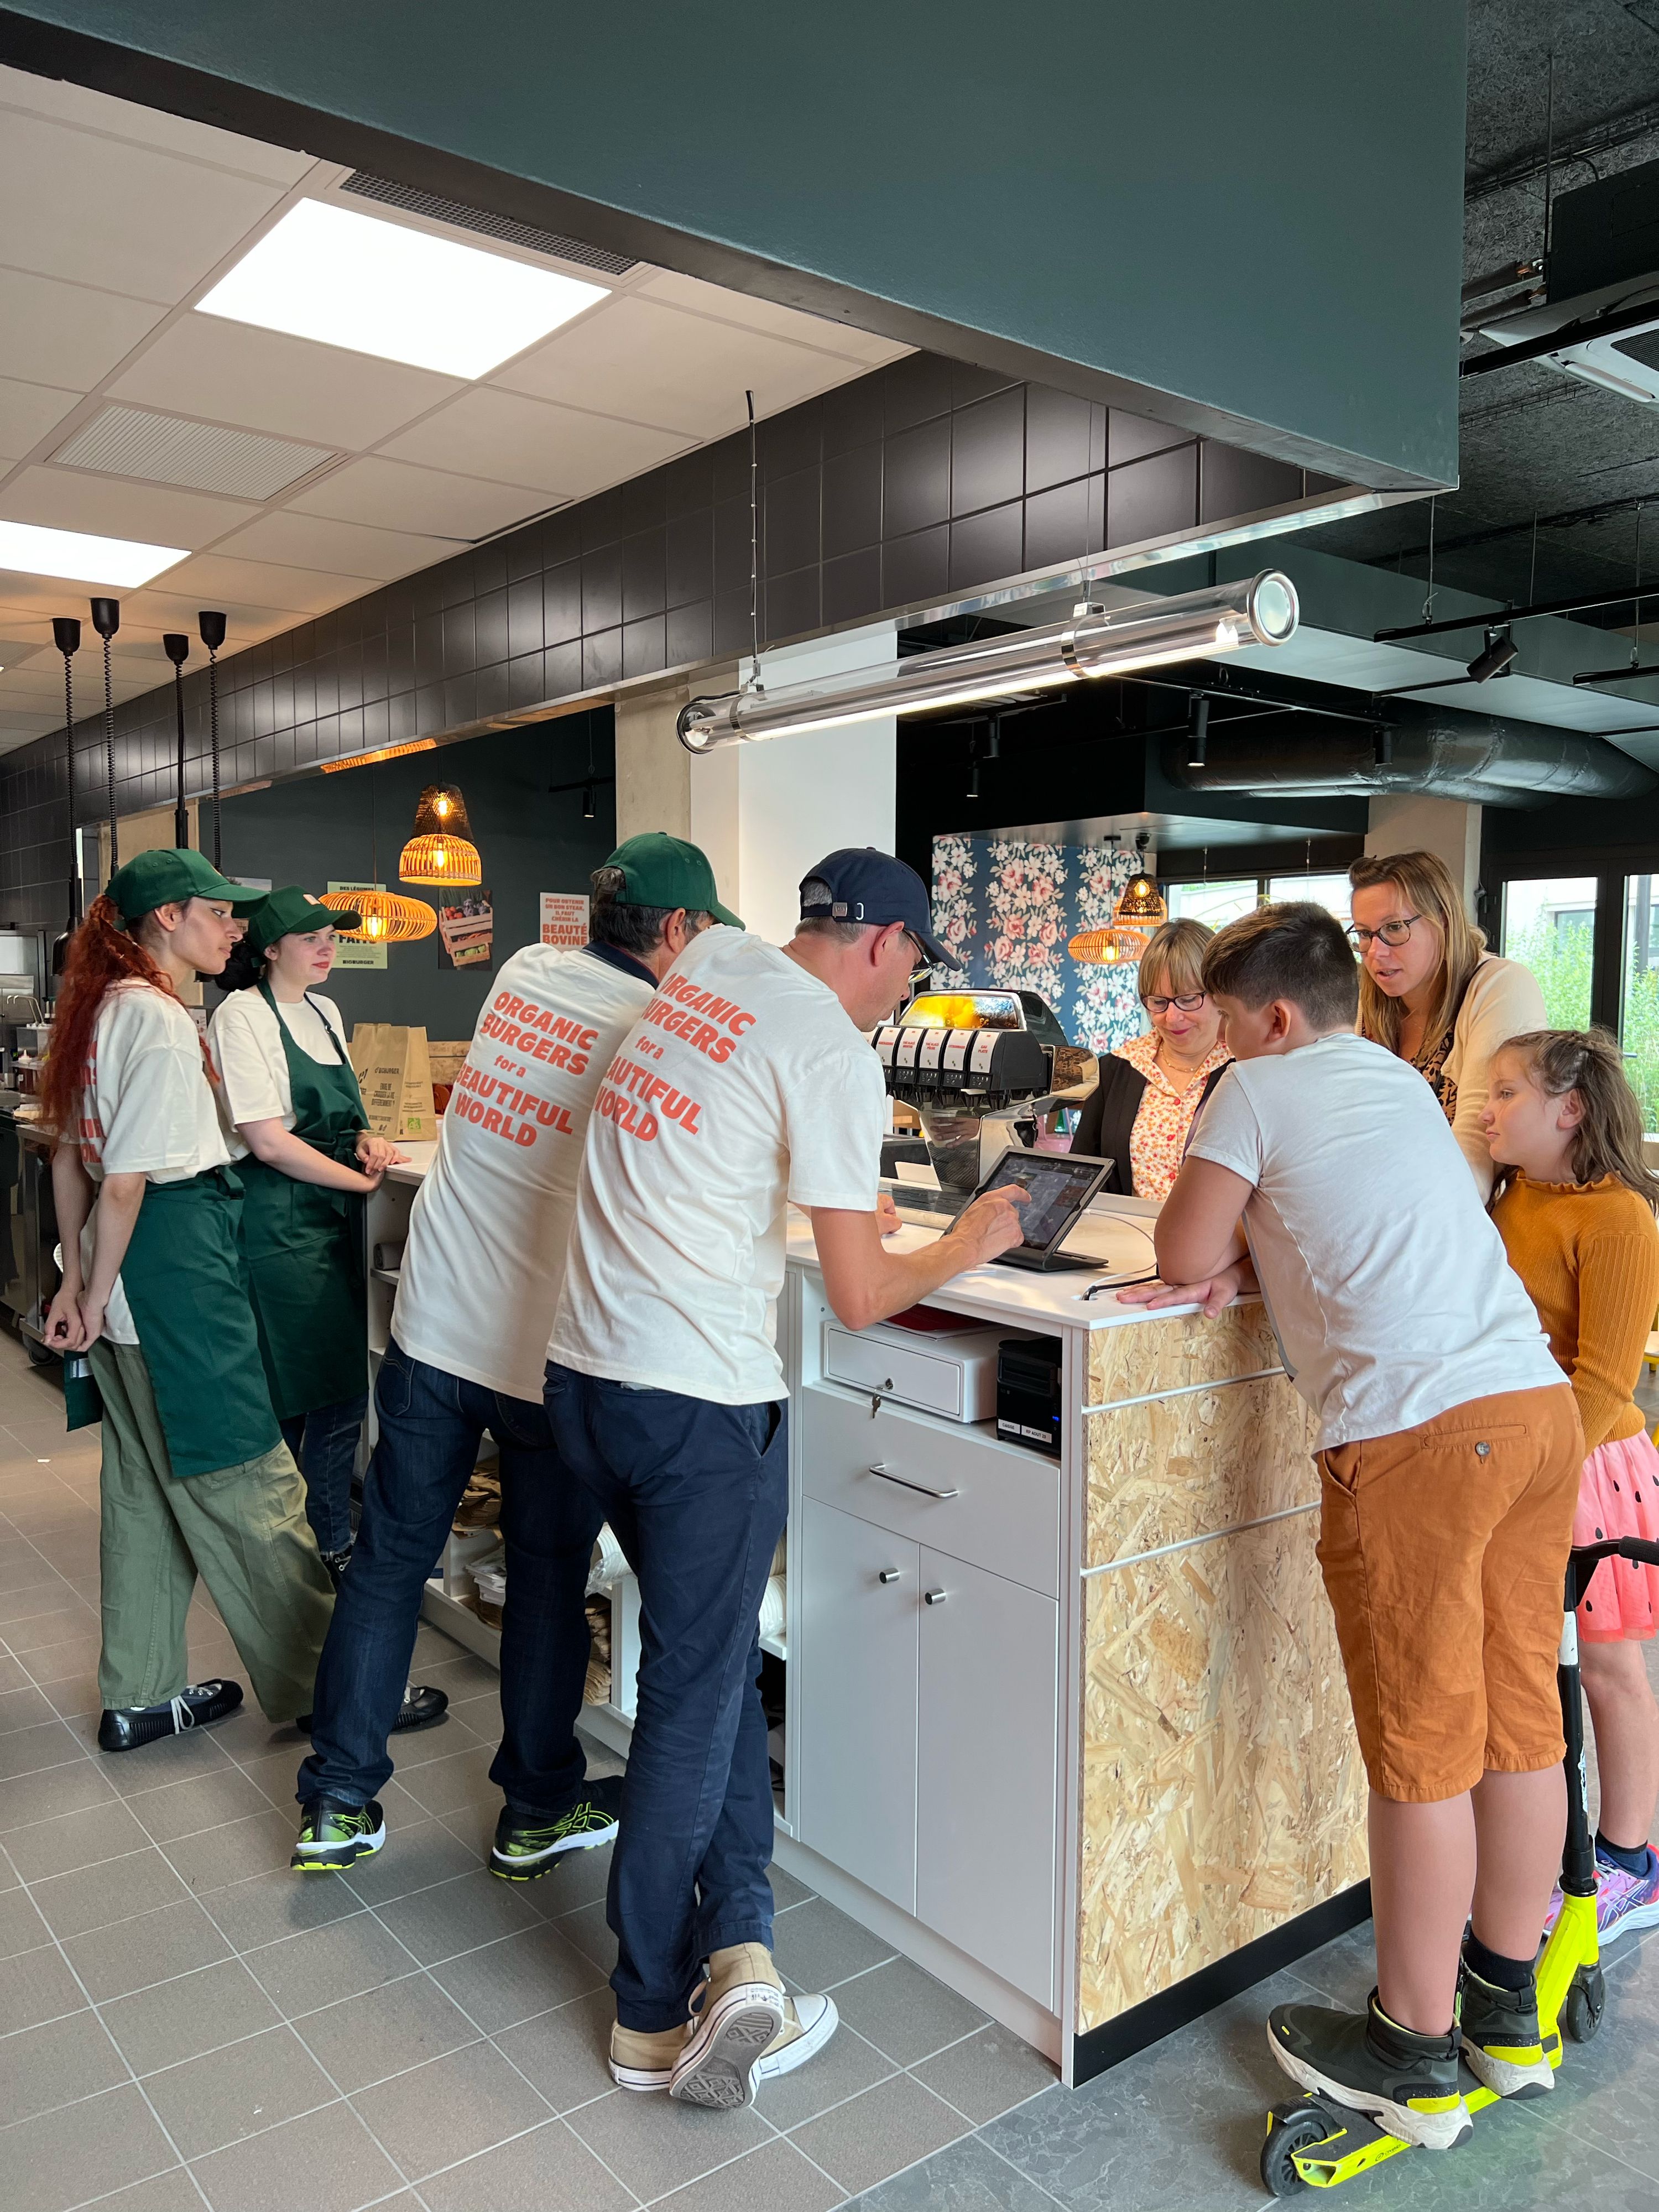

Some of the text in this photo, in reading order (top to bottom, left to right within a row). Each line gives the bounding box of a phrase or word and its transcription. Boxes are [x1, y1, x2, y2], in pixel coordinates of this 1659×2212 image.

[542, 923, 587, 935] BEAUTÉ
[543, 935, 587, 945] BOVINE
[494, 992, 599, 1050] ORGANIC
[641, 998, 737, 1063] URGERS
[659, 973, 757, 1036] ORGANIC
[480, 1014, 589, 1075] BURGERS
[494, 1055, 526, 1077] for a
[635, 1036, 664, 1060] for a
[455, 1092, 537, 1146] WORLD
[456, 1063, 573, 1135] BEAUTIFUL
[606, 1056, 701, 1135] AUTIFUL
